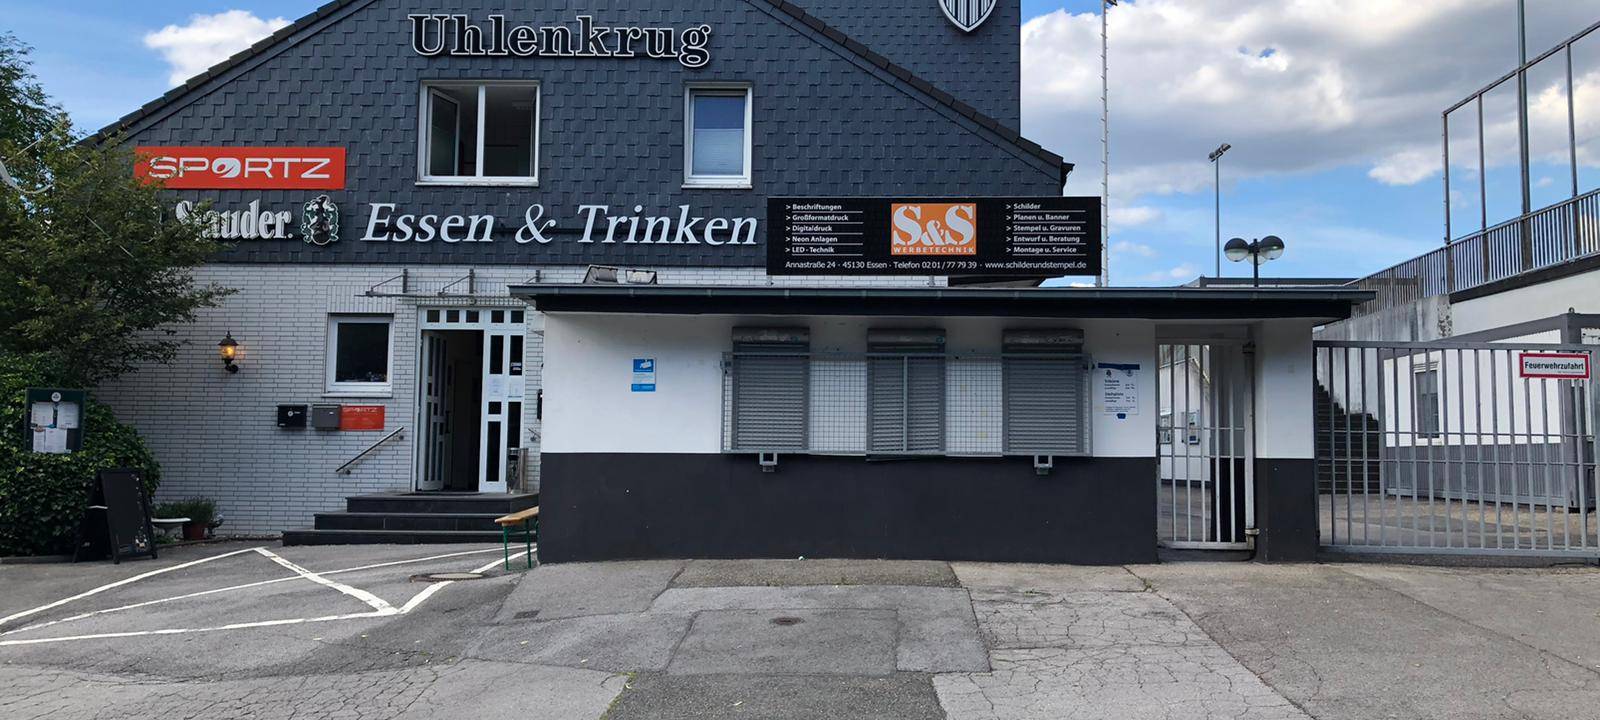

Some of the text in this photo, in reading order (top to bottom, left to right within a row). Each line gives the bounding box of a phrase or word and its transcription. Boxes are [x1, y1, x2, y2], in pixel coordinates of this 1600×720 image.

[408, 14, 711, 67] Uhlenkrug
[149, 156, 331, 178] SPORTZ
[792, 203, 842, 211] Beschriftungen
[363, 203, 758, 246] Essen & Trinken
[792, 225, 833, 233] Digitaldruck
[893, 205, 974, 246] S&S
[785, 261, 826, 269] Annastraße
[843, 261, 866, 269] 45130
[894, 261, 921, 269] Telefon
[985, 261, 1087, 271] www.schilderundstempel.de
[1524, 361, 1584, 370] Feuerwehrzufahrt
